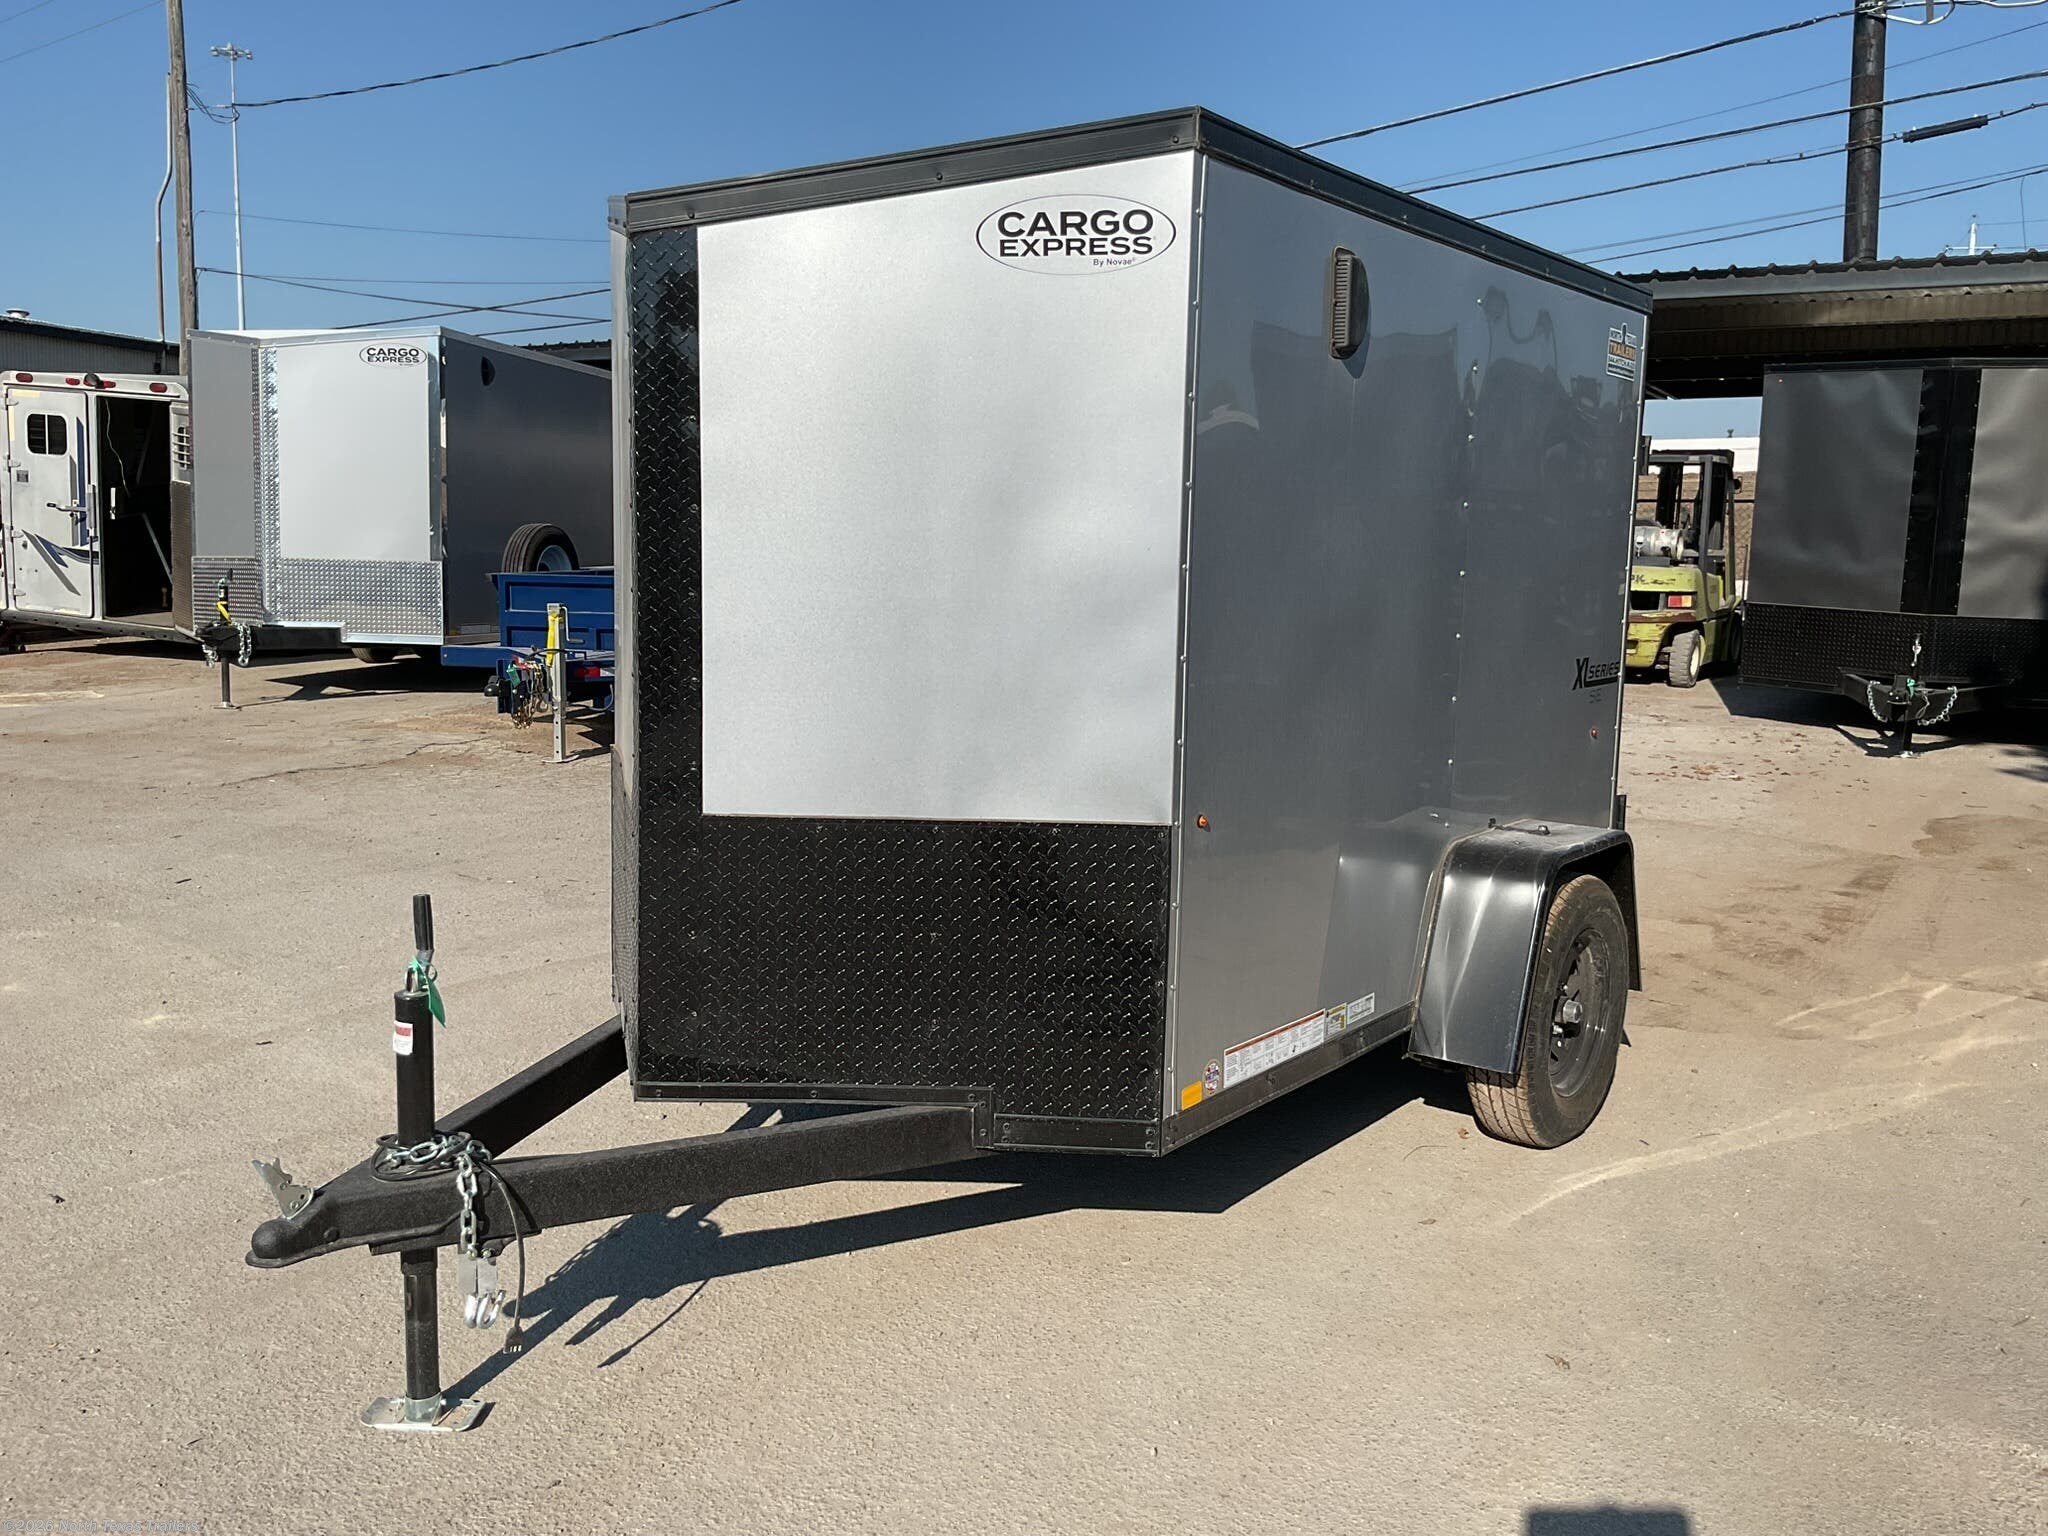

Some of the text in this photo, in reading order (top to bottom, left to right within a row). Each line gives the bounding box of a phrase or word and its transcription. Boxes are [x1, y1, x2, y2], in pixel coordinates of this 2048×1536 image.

[998, 209, 1154, 238] CARGO
[999, 236, 1153, 257] EXPRESS
[1093, 258, 1104, 266] By
[366, 347, 420, 357] CARGO
[1588, 661, 1620, 679] SERIES
